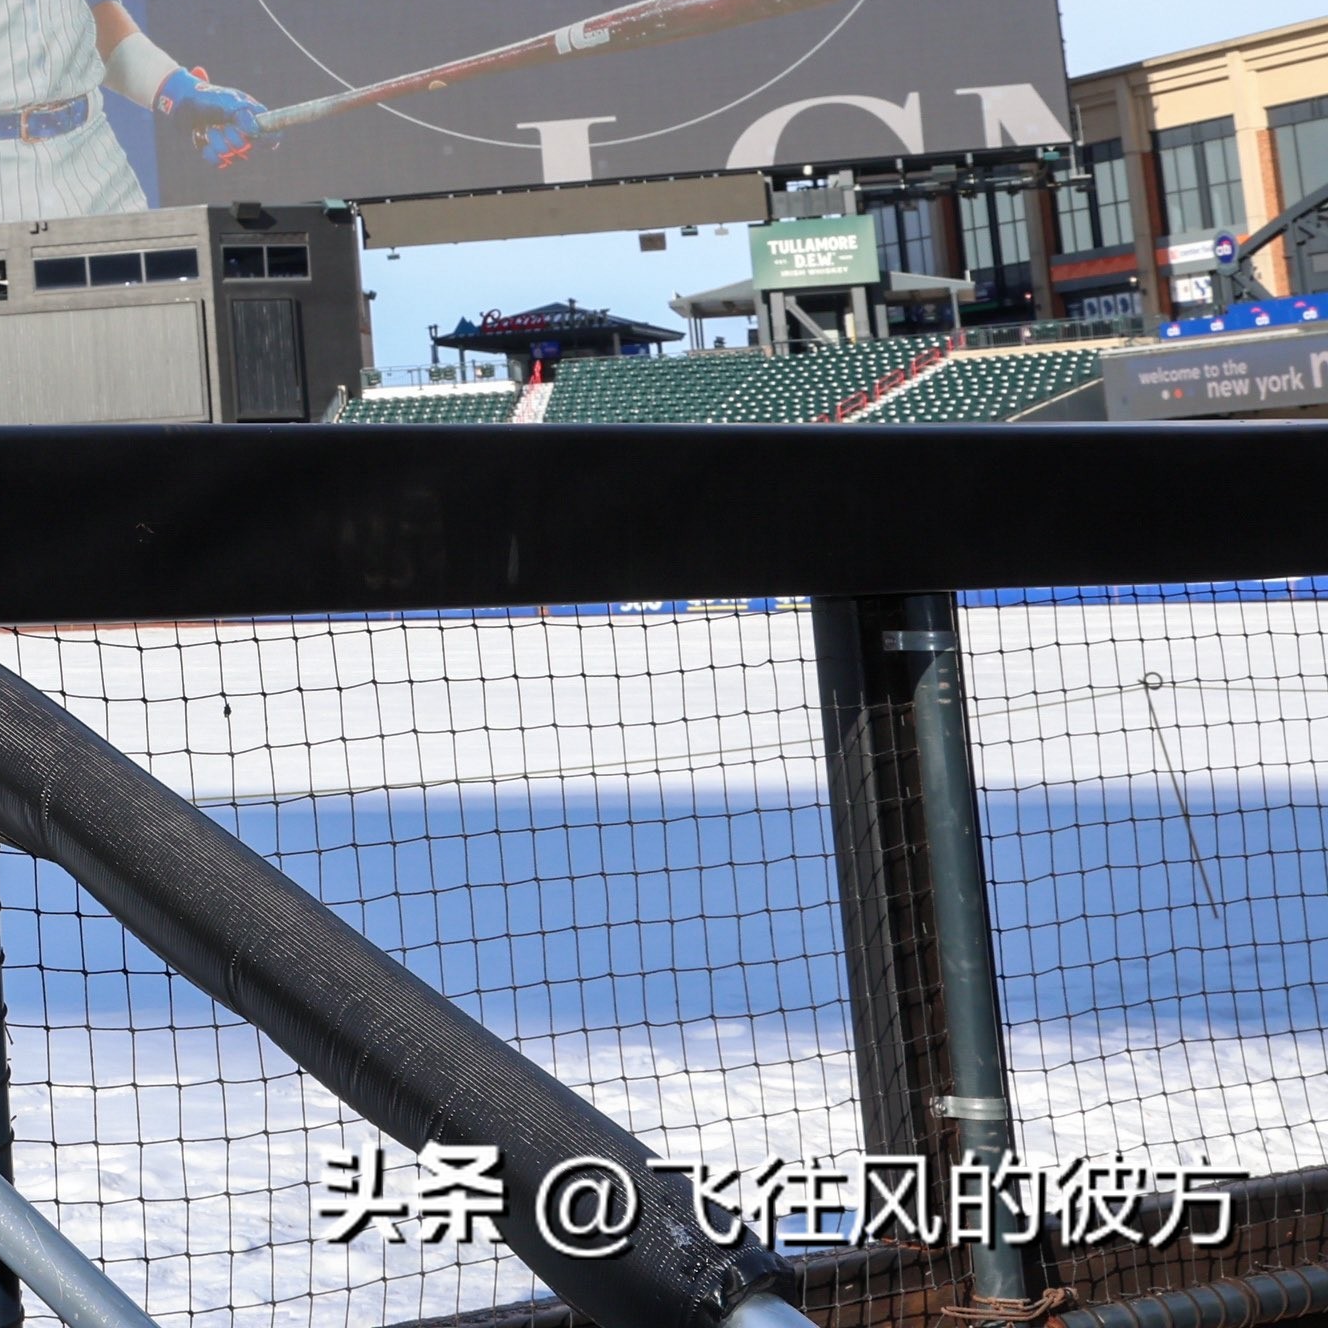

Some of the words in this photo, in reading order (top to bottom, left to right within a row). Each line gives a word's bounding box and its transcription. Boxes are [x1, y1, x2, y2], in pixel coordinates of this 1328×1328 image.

[767, 234, 859, 255] TULLAMORE
[1138, 367, 1201, 385] welcome
[1203, 364, 1220, 377] to
[1222, 359, 1248, 376] the
[1206, 377, 1250, 399] new
[1255, 366, 1304, 401] york
